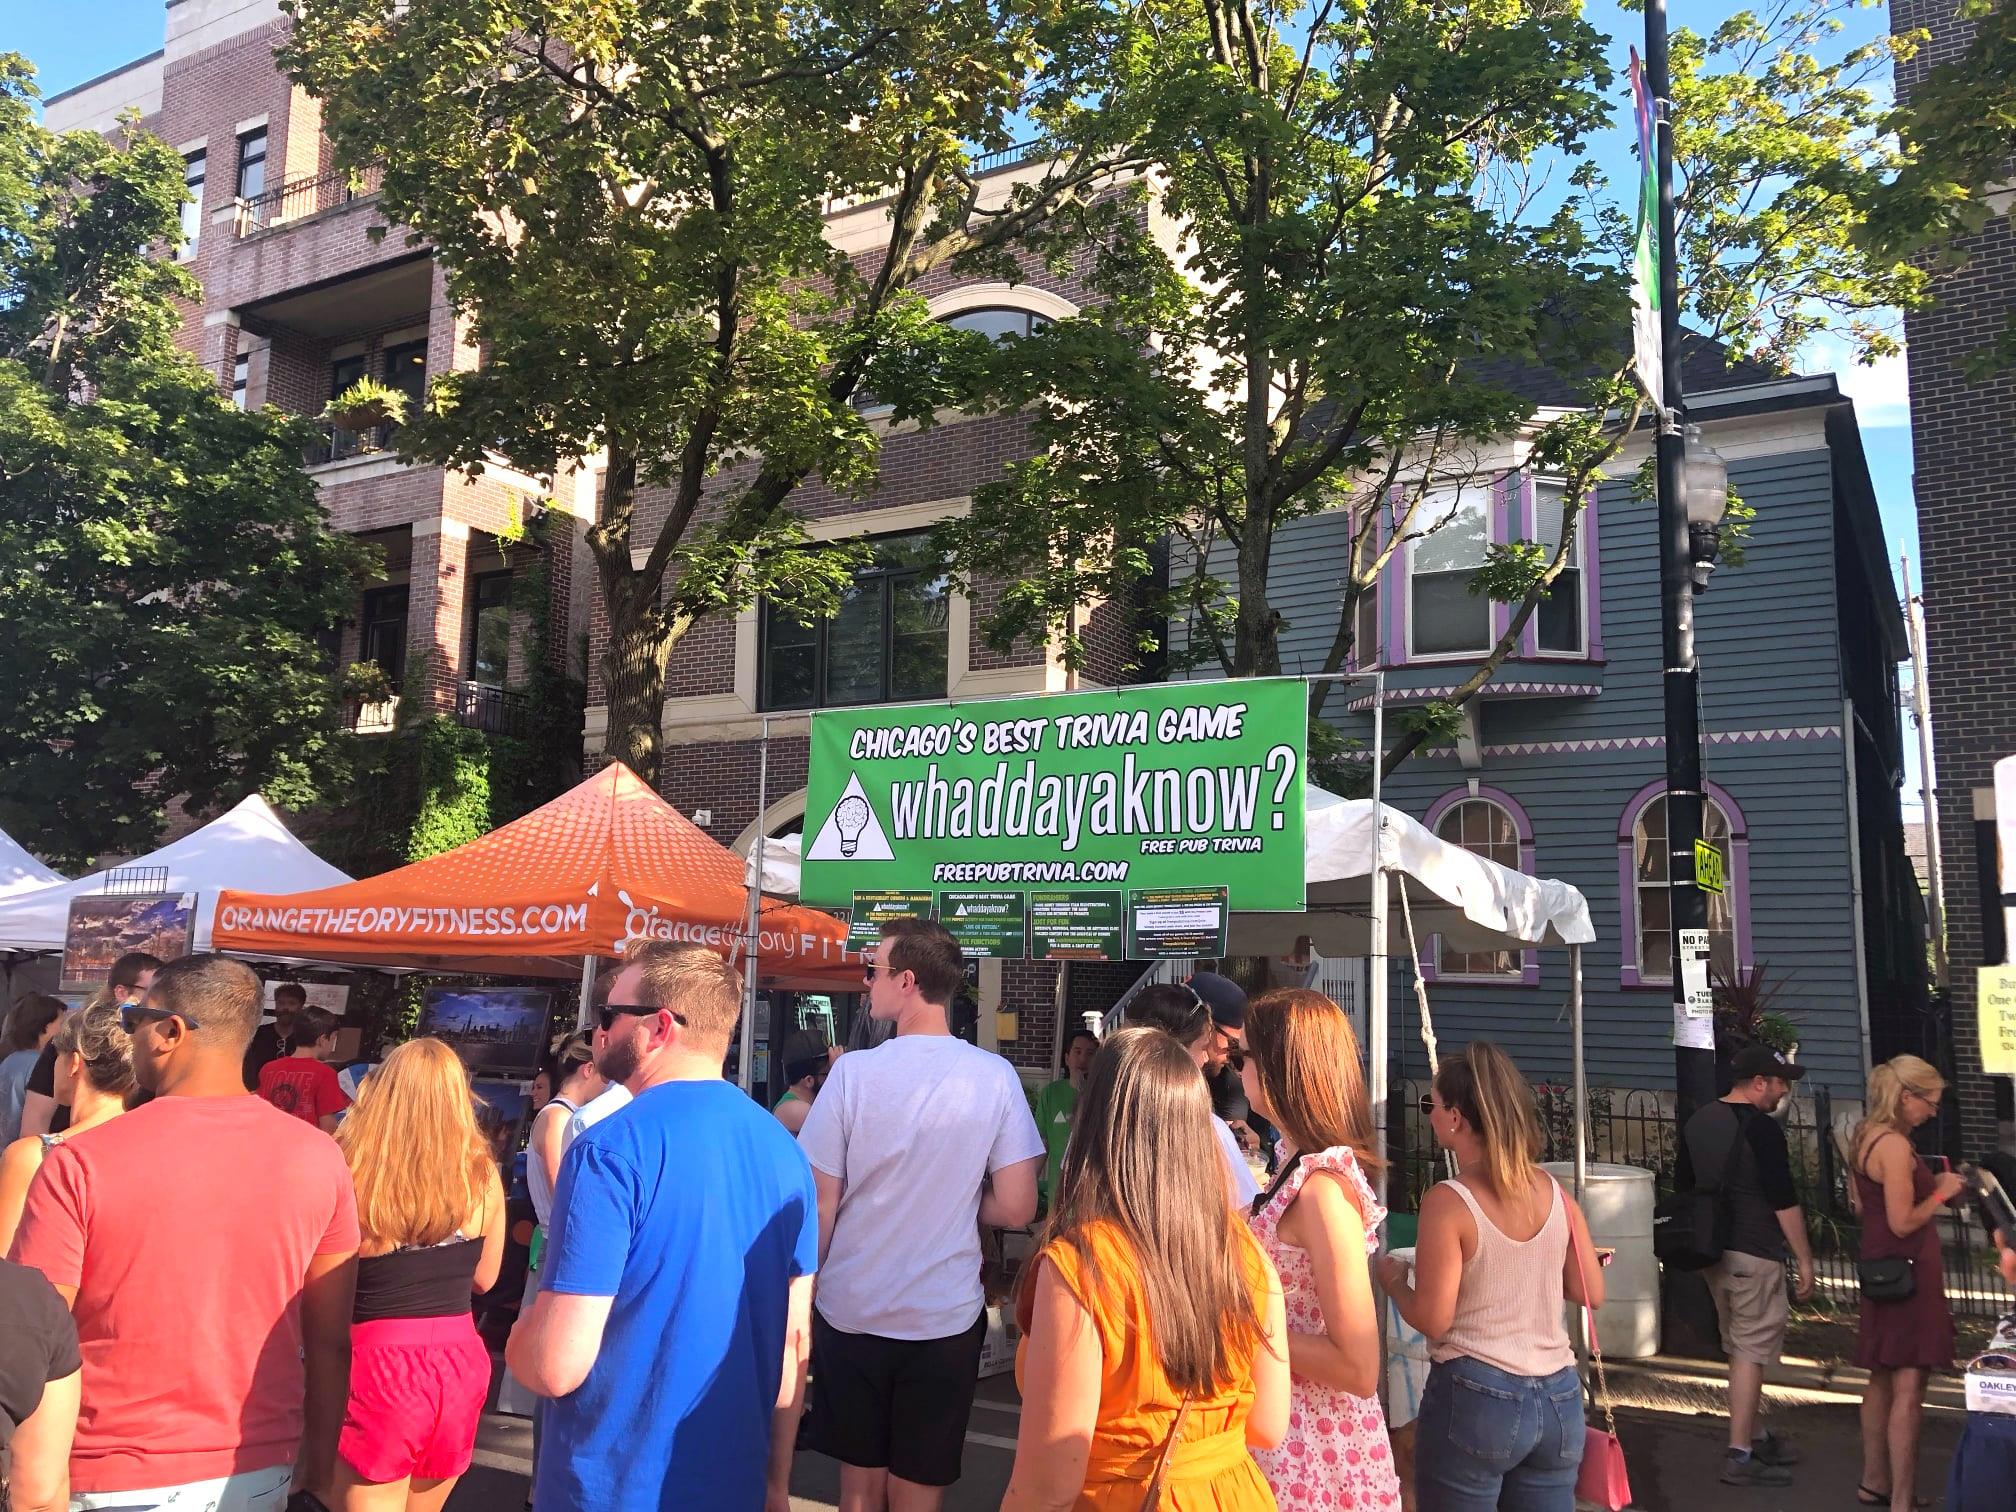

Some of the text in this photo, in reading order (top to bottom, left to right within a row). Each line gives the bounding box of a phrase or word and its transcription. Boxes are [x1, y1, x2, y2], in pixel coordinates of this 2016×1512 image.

[849, 704, 1247, 760] CHICAGO'S BEST TRIVIA GAME
[891, 745, 1297, 852] whaddayaknow?
[1140, 837, 1262, 854] FREE PUB TRIVIA
[933, 861, 1128, 883] FREEPUBTRIVIA.COM
[1700, 850, 1720, 884] AHEAD
[221, 903, 588, 935] ORANGETHEORYFITNESS.COM
[1682, 935, 1695, 945] NO
